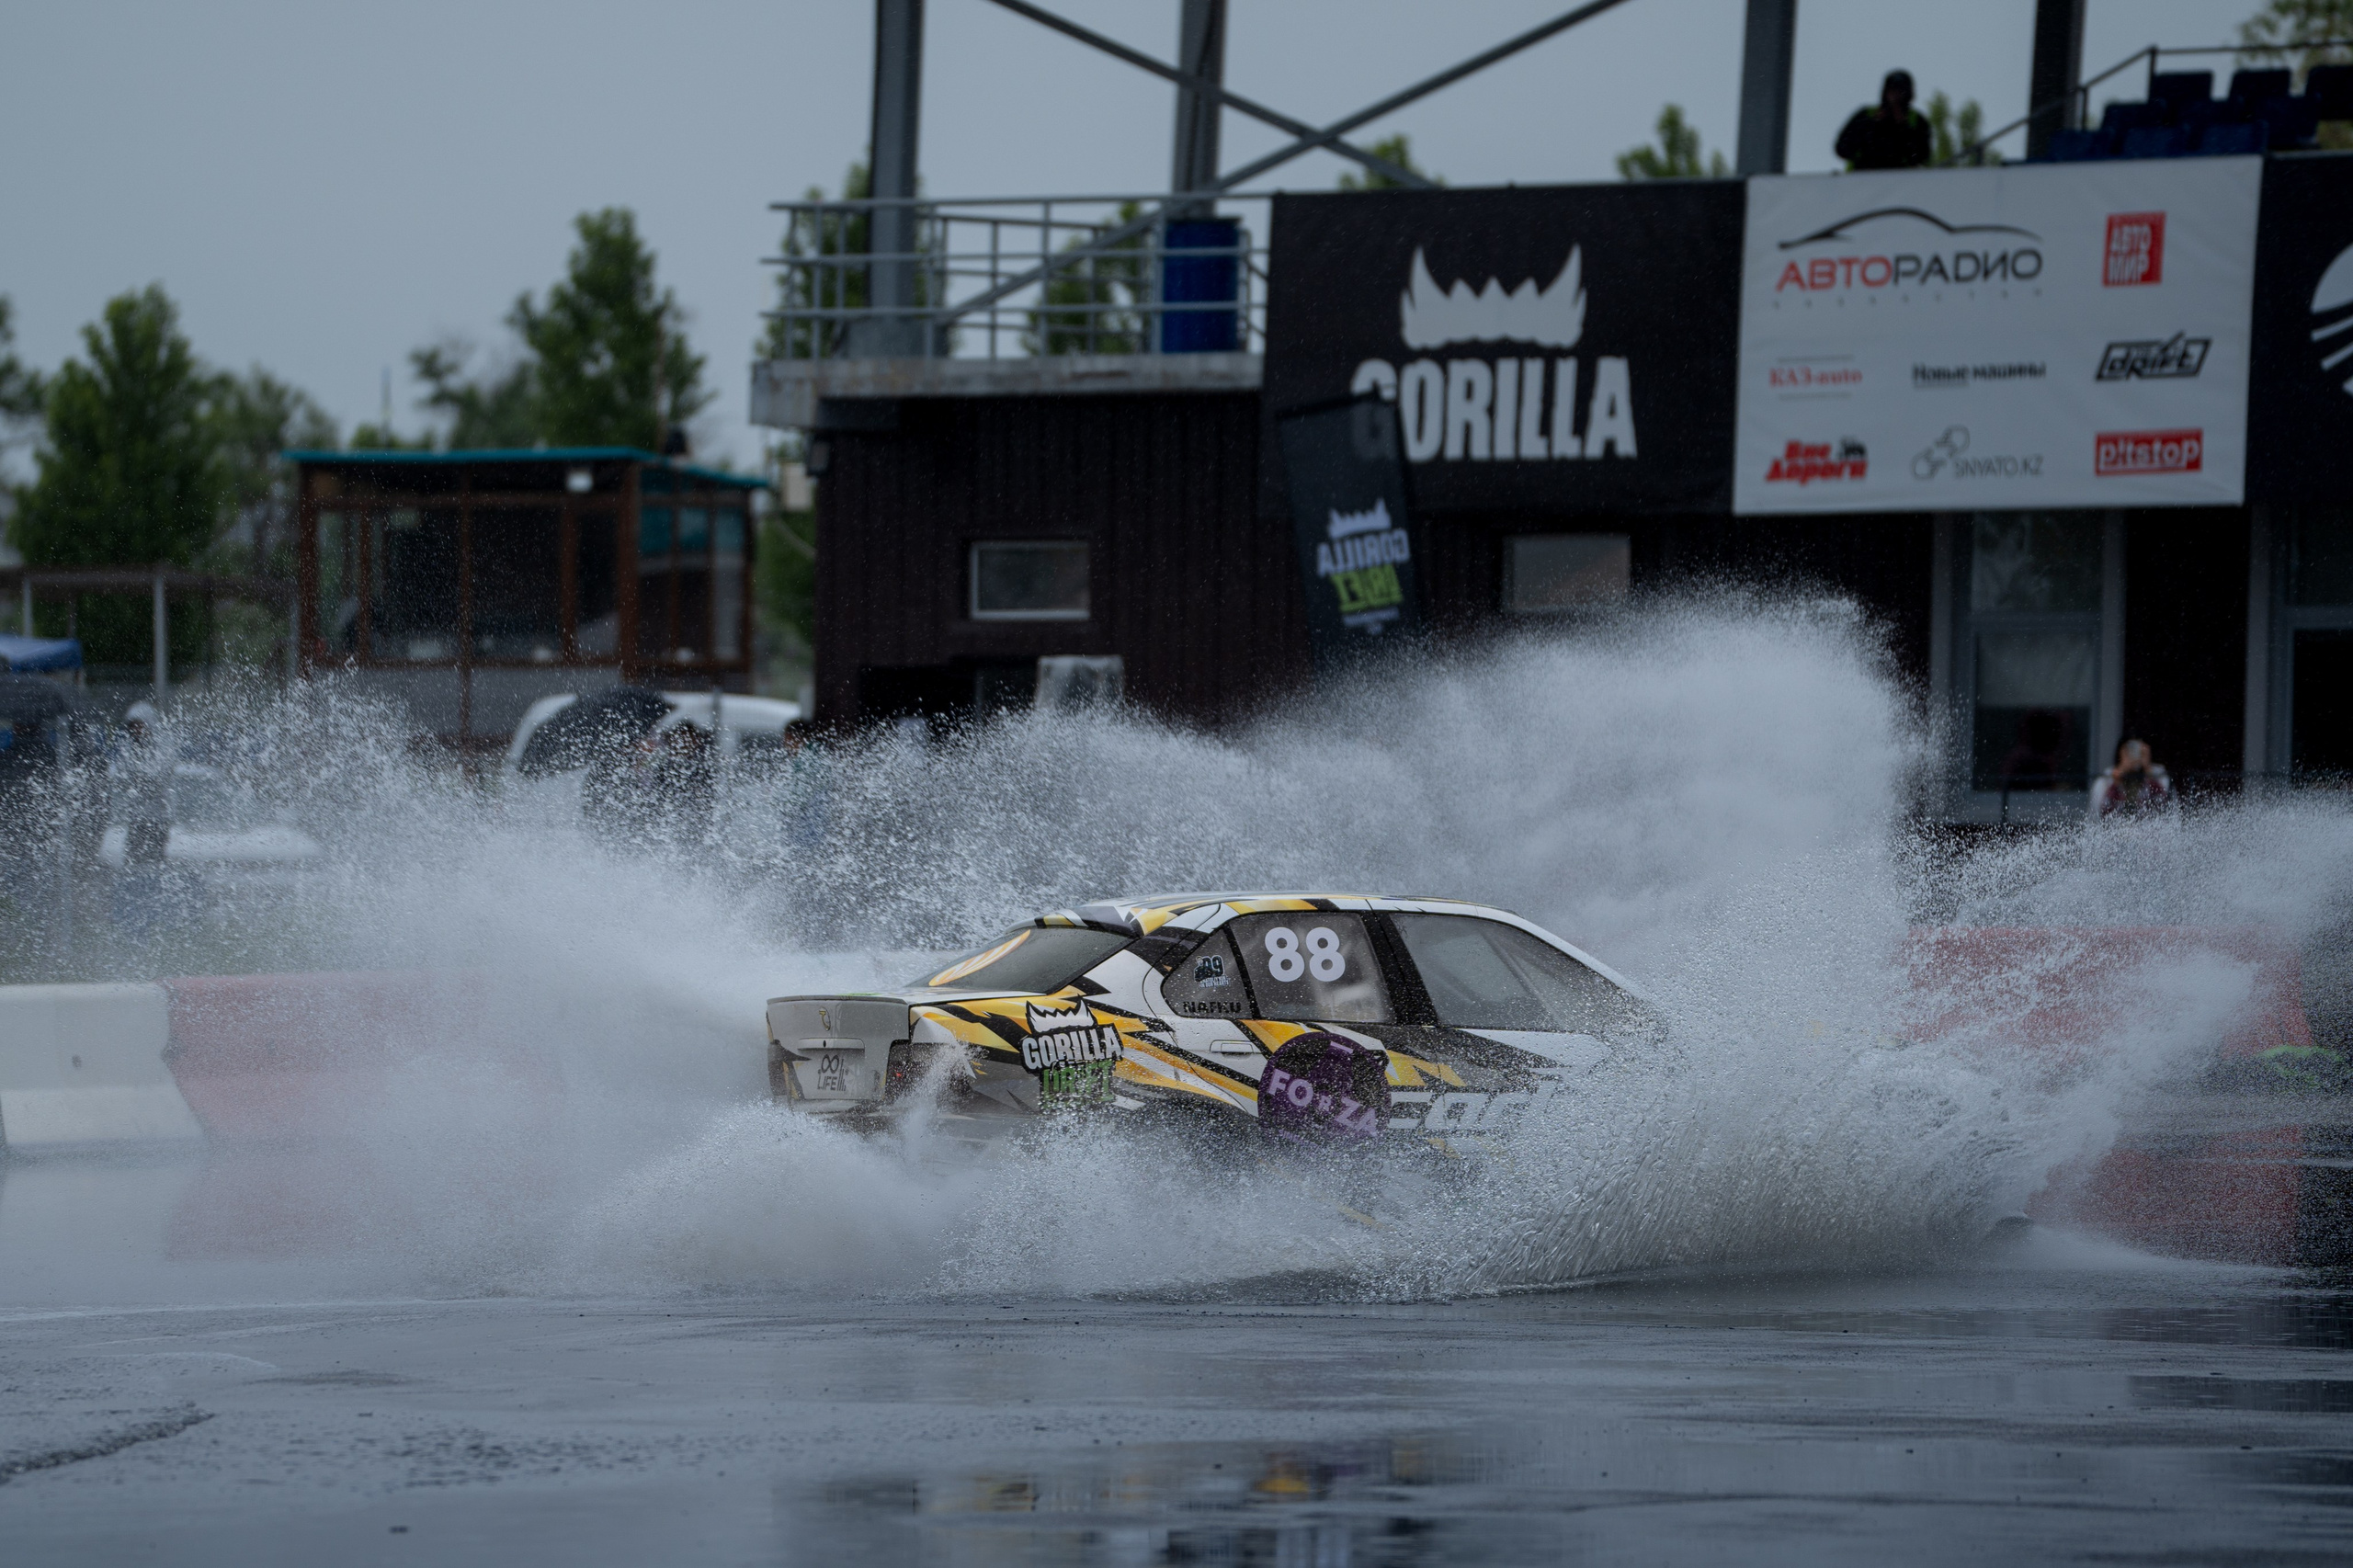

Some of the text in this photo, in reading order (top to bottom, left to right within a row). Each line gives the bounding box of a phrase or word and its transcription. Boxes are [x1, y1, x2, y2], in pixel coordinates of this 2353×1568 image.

[1265, 926, 1346, 982] 88
[1022, 1026, 1121, 1070] GORILLA
[1267, 1068, 1379, 1137] FORZA
